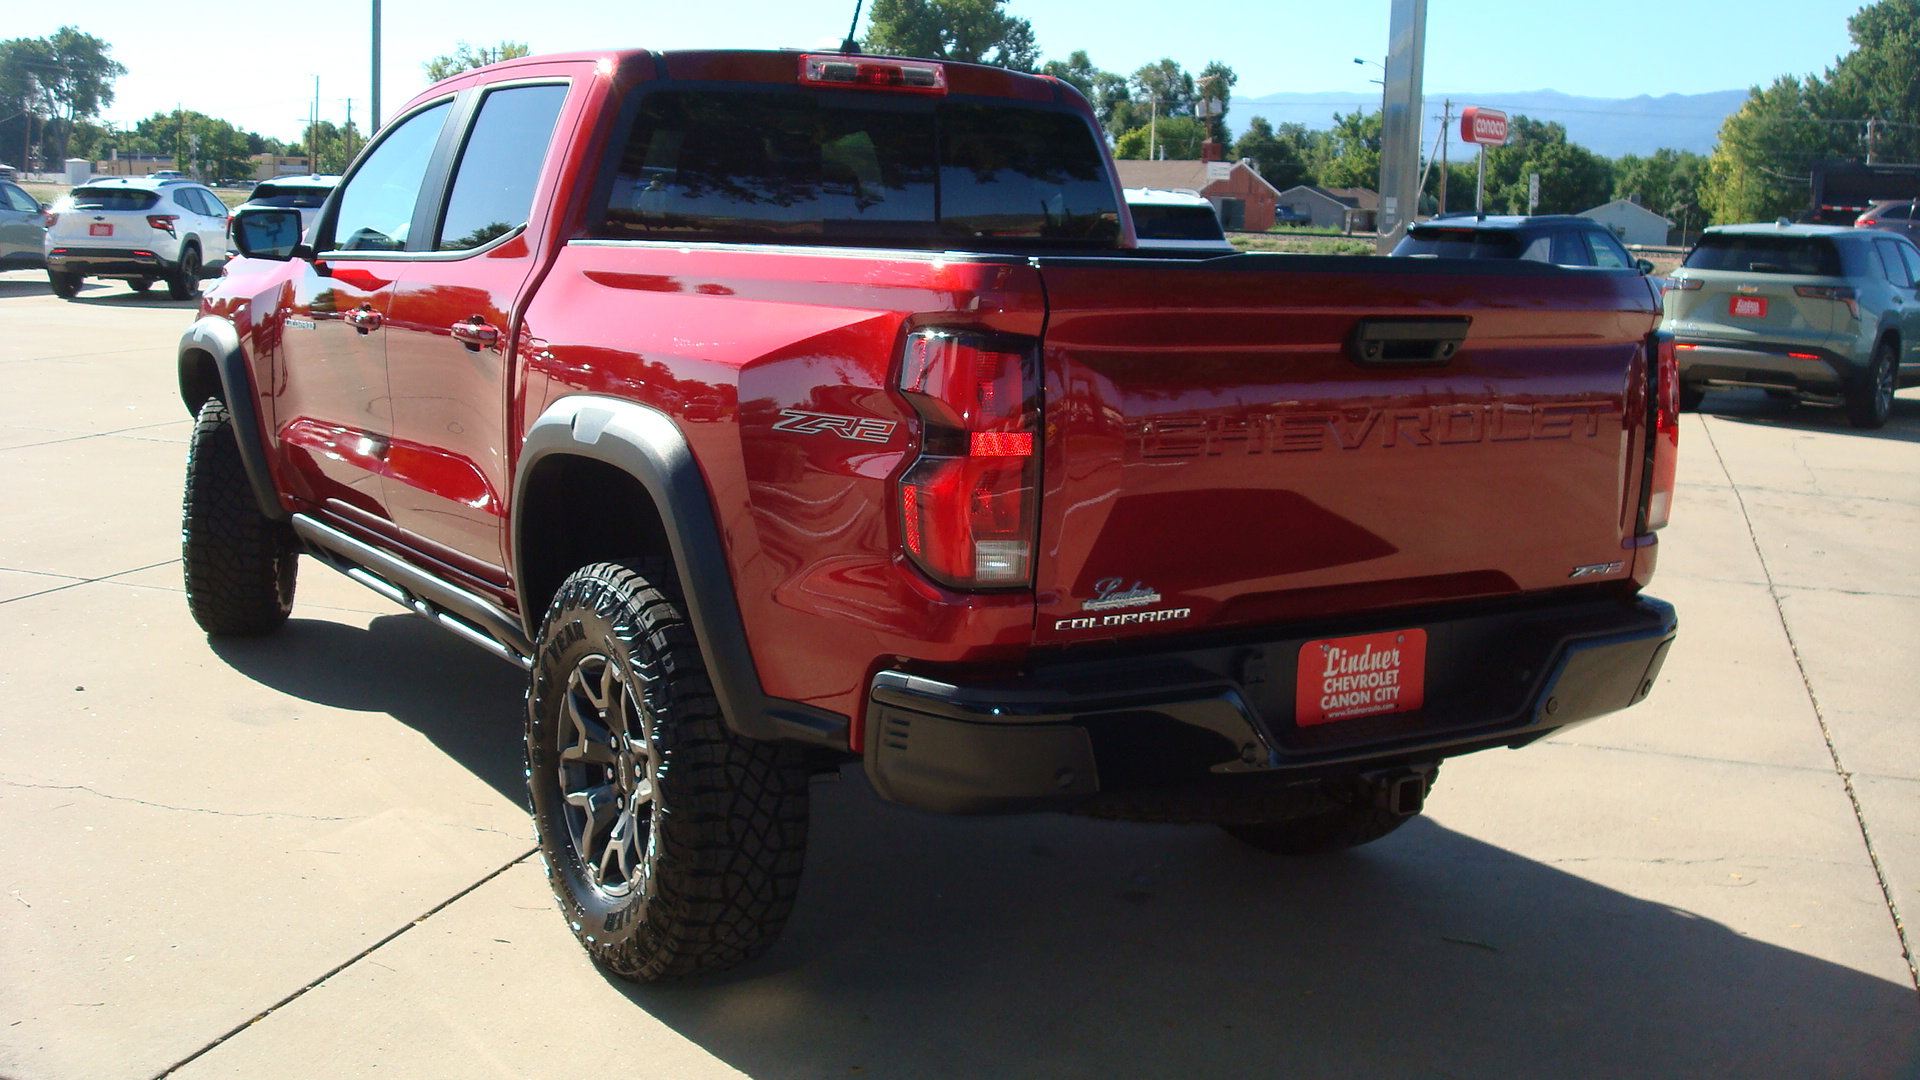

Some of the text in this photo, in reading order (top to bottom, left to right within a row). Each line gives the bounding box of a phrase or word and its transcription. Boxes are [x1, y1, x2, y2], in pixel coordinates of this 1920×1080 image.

[772, 408, 897, 444] ZR2
[1141, 401, 1614, 459] CHEVROLET
[1055, 608, 1191, 631] COLORADO
[1323, 643, 1401, 677] Lindner
[1323, 669, 1399, 694] CHEVROLET
[1320, 686, 1401, 710] CANON CITY
